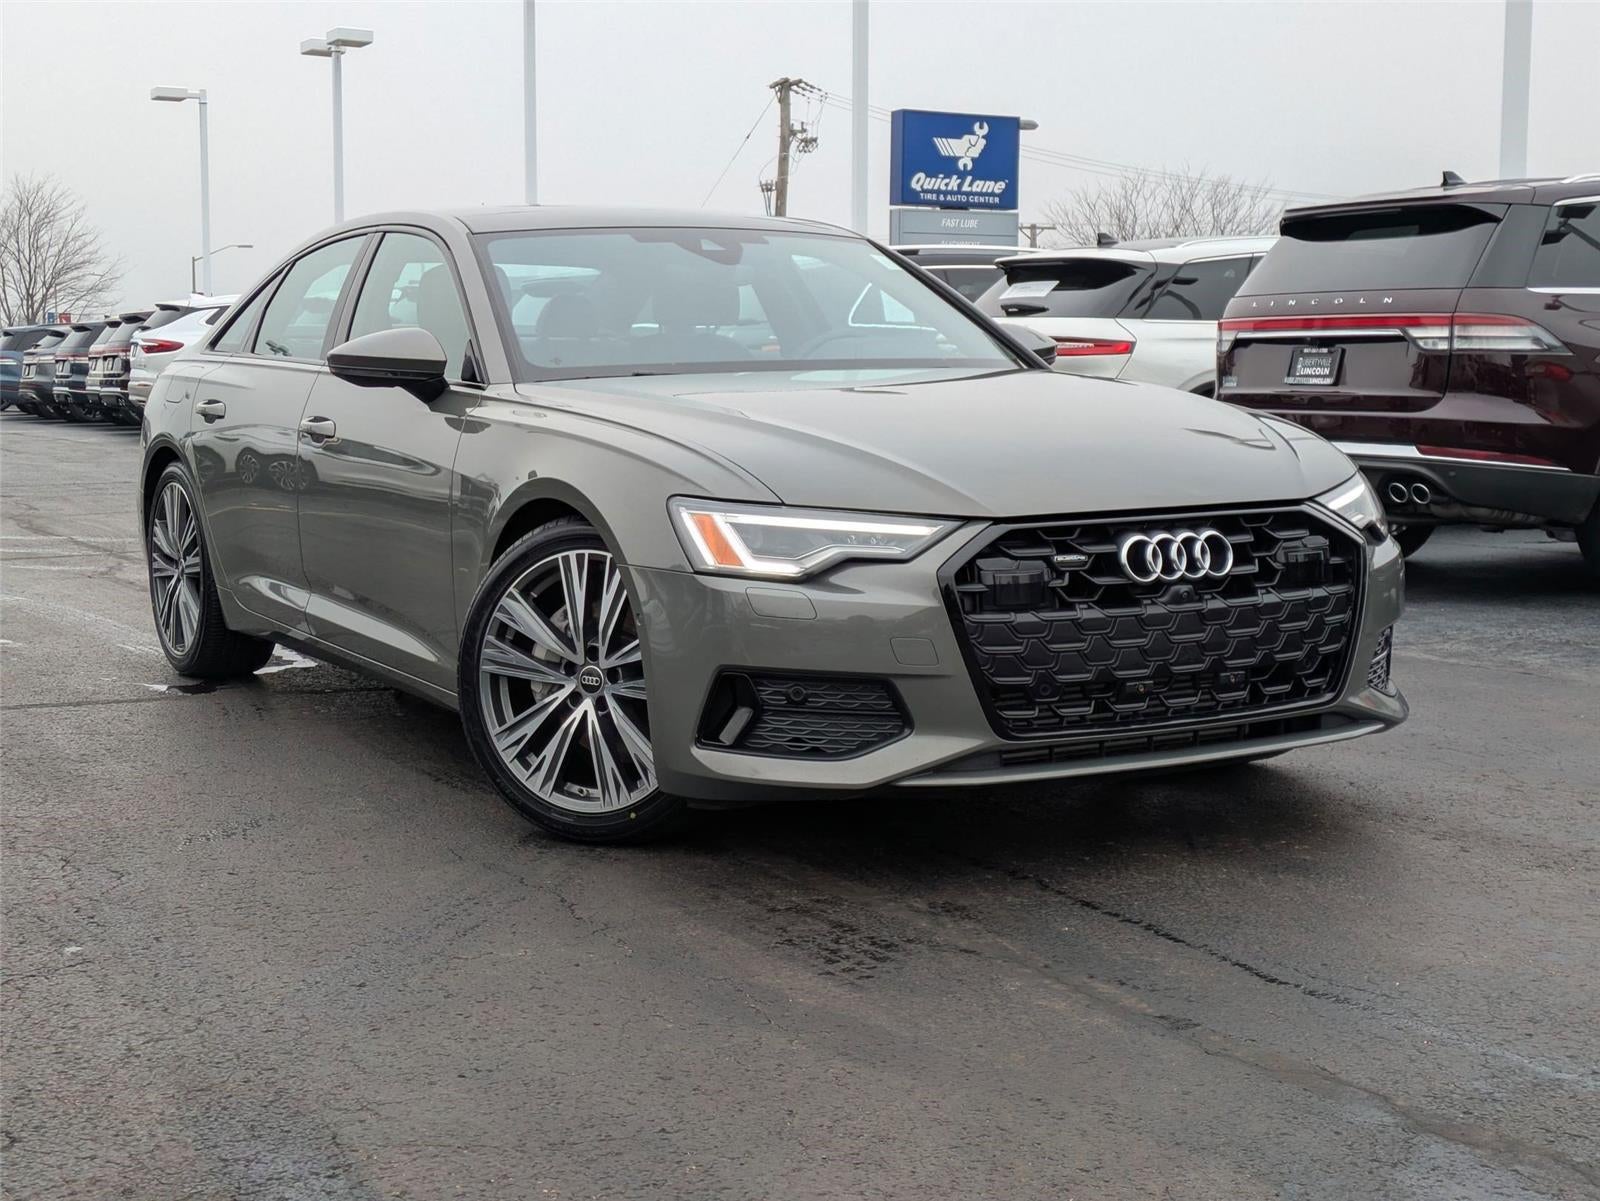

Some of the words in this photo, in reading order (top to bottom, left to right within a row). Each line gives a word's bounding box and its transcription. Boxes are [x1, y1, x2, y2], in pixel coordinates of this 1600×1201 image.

[911, 172, 961, 191] Quick
[961, 175, 1006, 194] Lane
[919, 193, 937, 201] TIRE
[968, 195, 1000, 204] CENTER
[942, 217, 960, 228] FAST
[961, 219, 979, 229] LUBE
[1252, 295, 1394, 307] LINCOLN
[1300, 367, 1330, 375] LINCOLN
